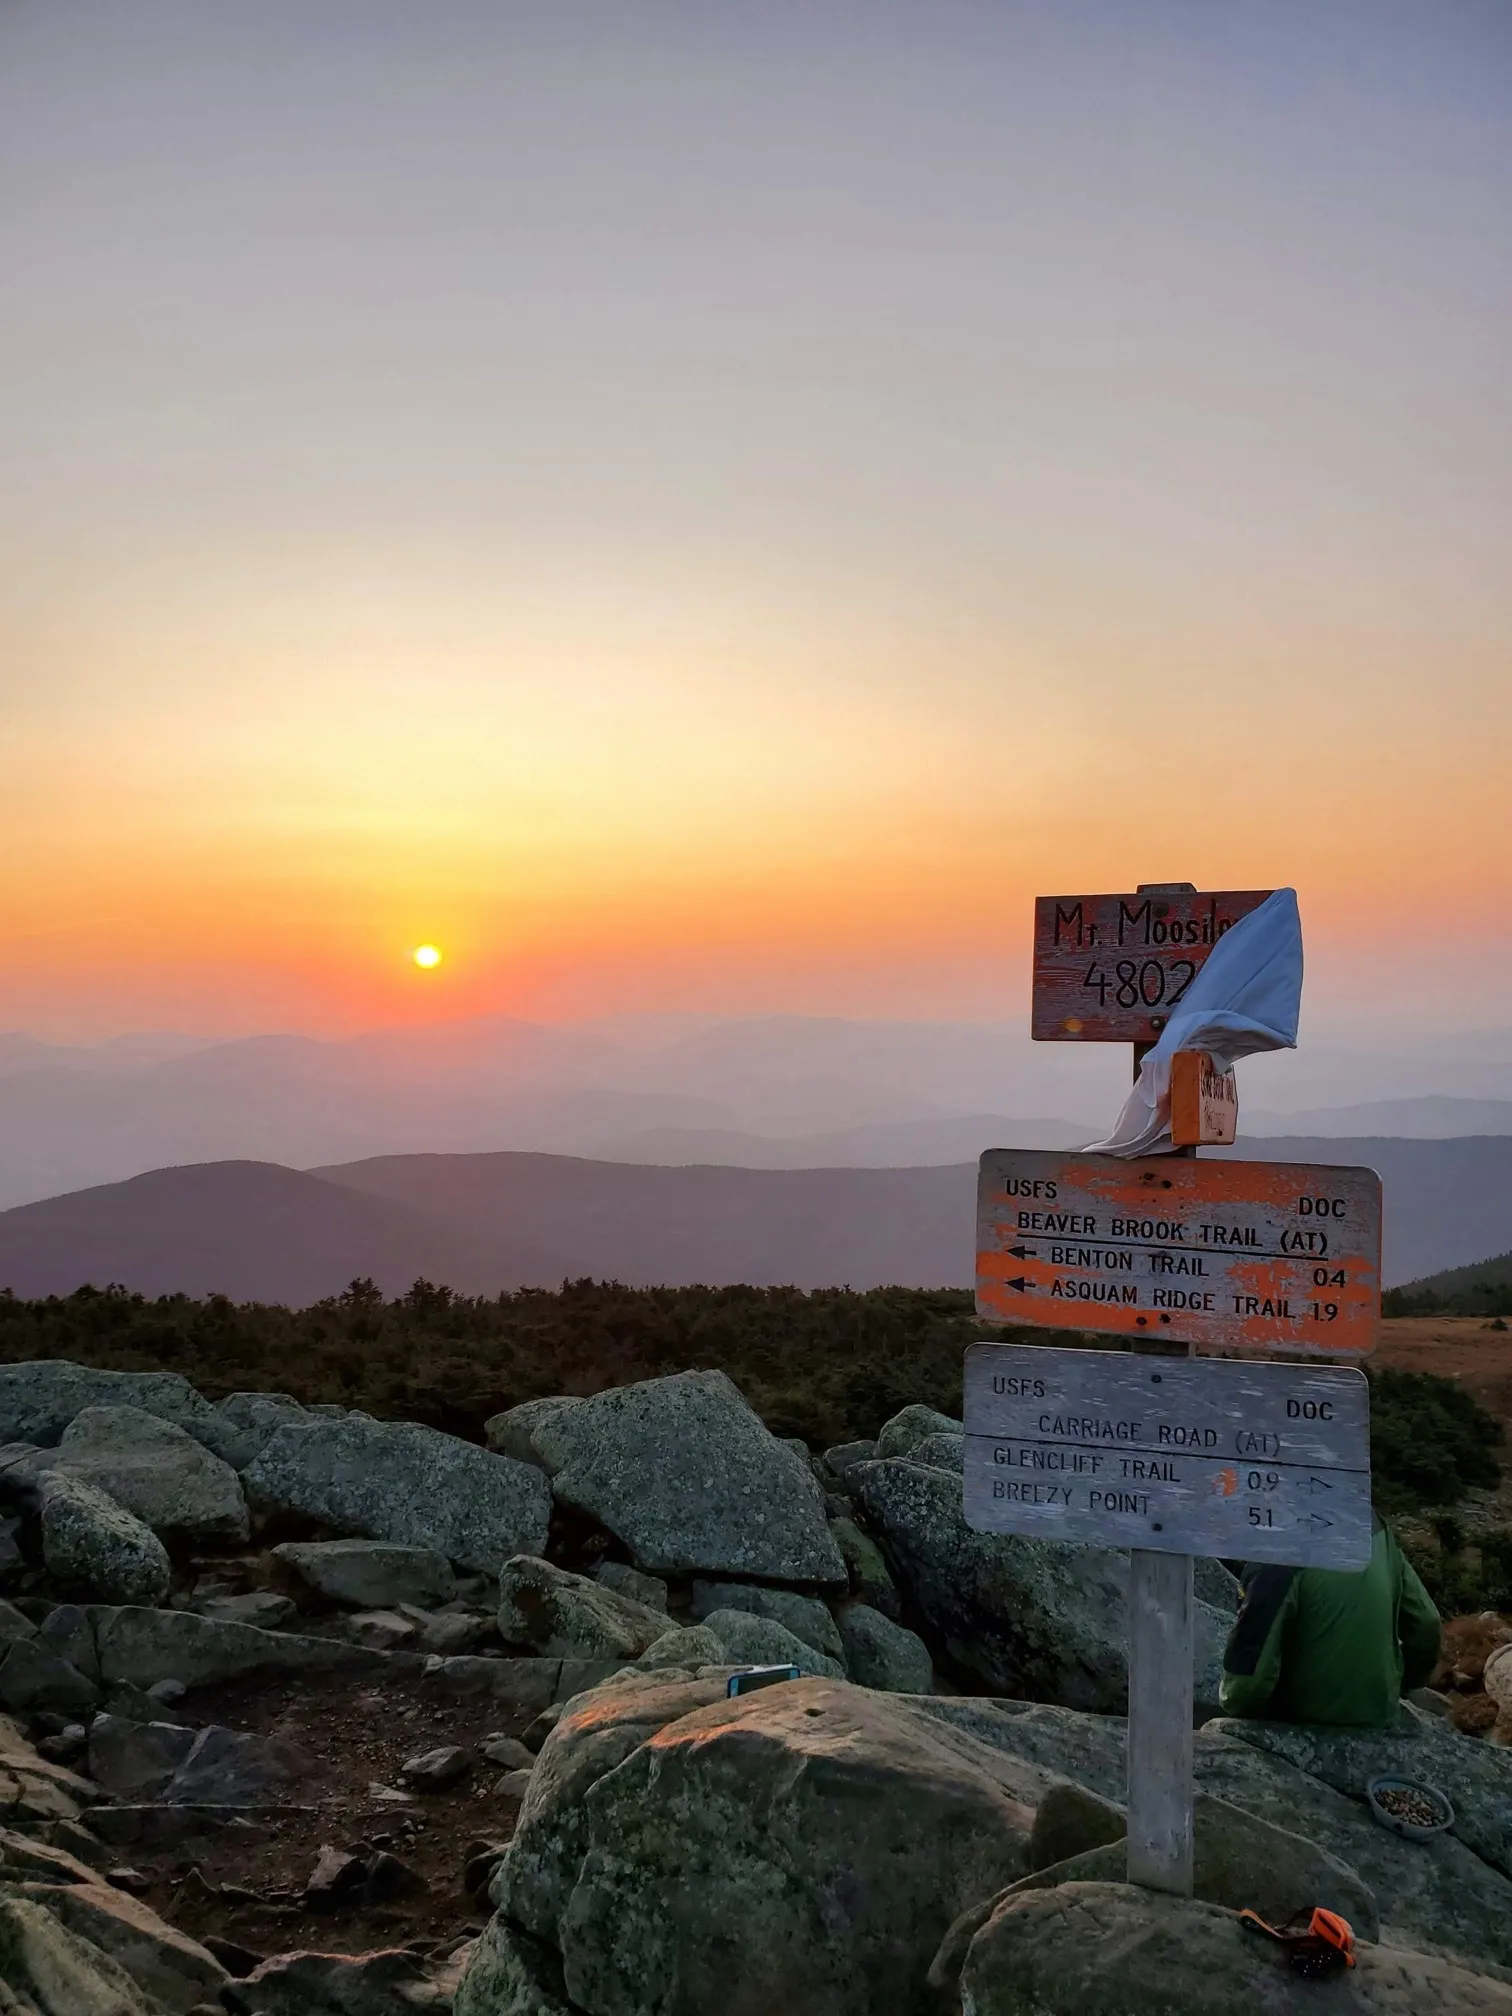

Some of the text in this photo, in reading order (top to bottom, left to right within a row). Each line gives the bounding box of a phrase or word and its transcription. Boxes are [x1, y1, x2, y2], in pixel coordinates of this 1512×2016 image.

[1083, 960, 1197, 1009] 4802
[1006, 1179, 1058, 1199] USFS
[1299, 1197, 1347, 1218] DOC
[1017, 1211, 1328, 1255] BEAVER BROOK TRAIL (AT)
[1051, 1246, 1346, 1288] BENTON TRAIL 0.4
[1051, 1279, 1338, 1322] ASQUAM RIDGE TRAIL 1.9
[993, 1376, 1046, 1398] USFS
[1286, 1399, 1334, 1421] DOC
[1038, 1415, 1281, 1457] CARRIAGE ROAD (AT)
[993, 1447, 1280, 1491] GLENCLIFF TRAIL 0.9
[1089, 1491, 1151, 1515] POINT
